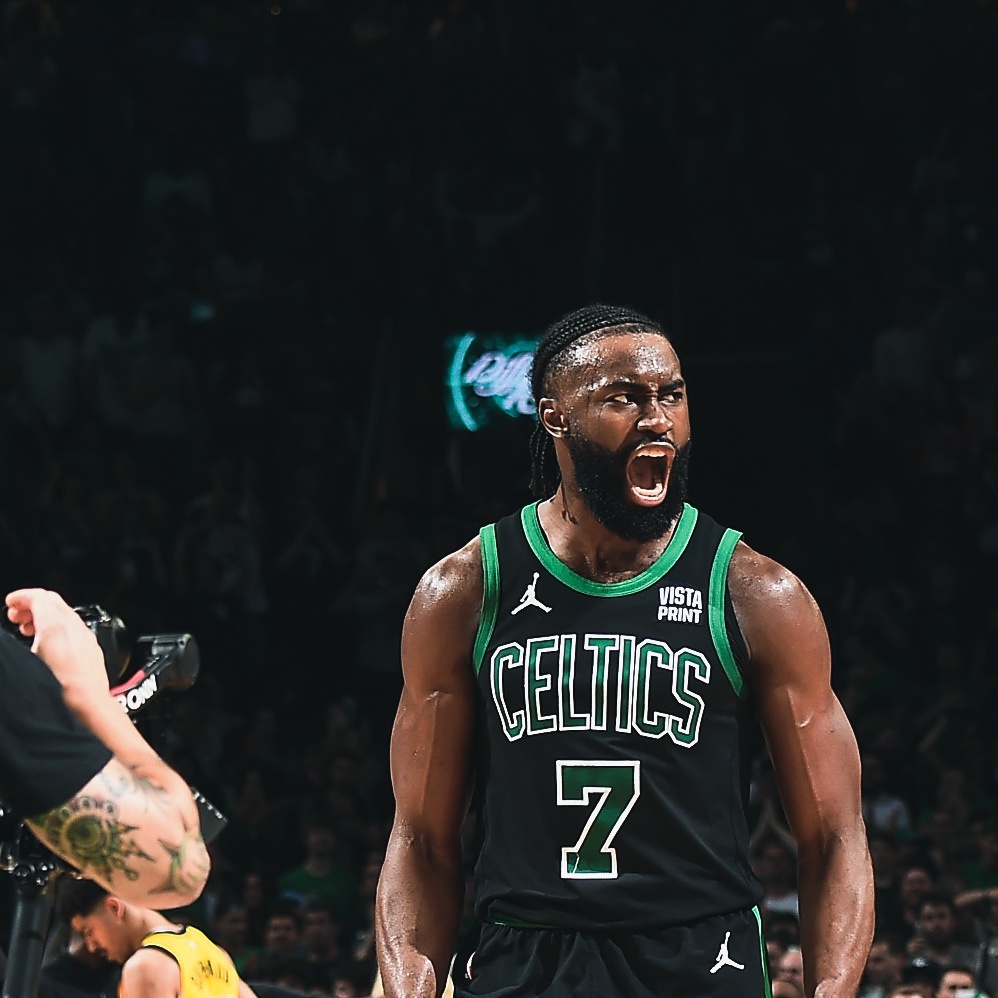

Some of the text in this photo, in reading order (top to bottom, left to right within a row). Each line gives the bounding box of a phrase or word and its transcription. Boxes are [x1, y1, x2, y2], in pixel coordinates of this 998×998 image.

[657, 606, 702, 624] PRINT
[659, 587, 702, 608] VISTA
[490, 633, 711, 749] CELTICS
[556, 759, 641, 880] 7
